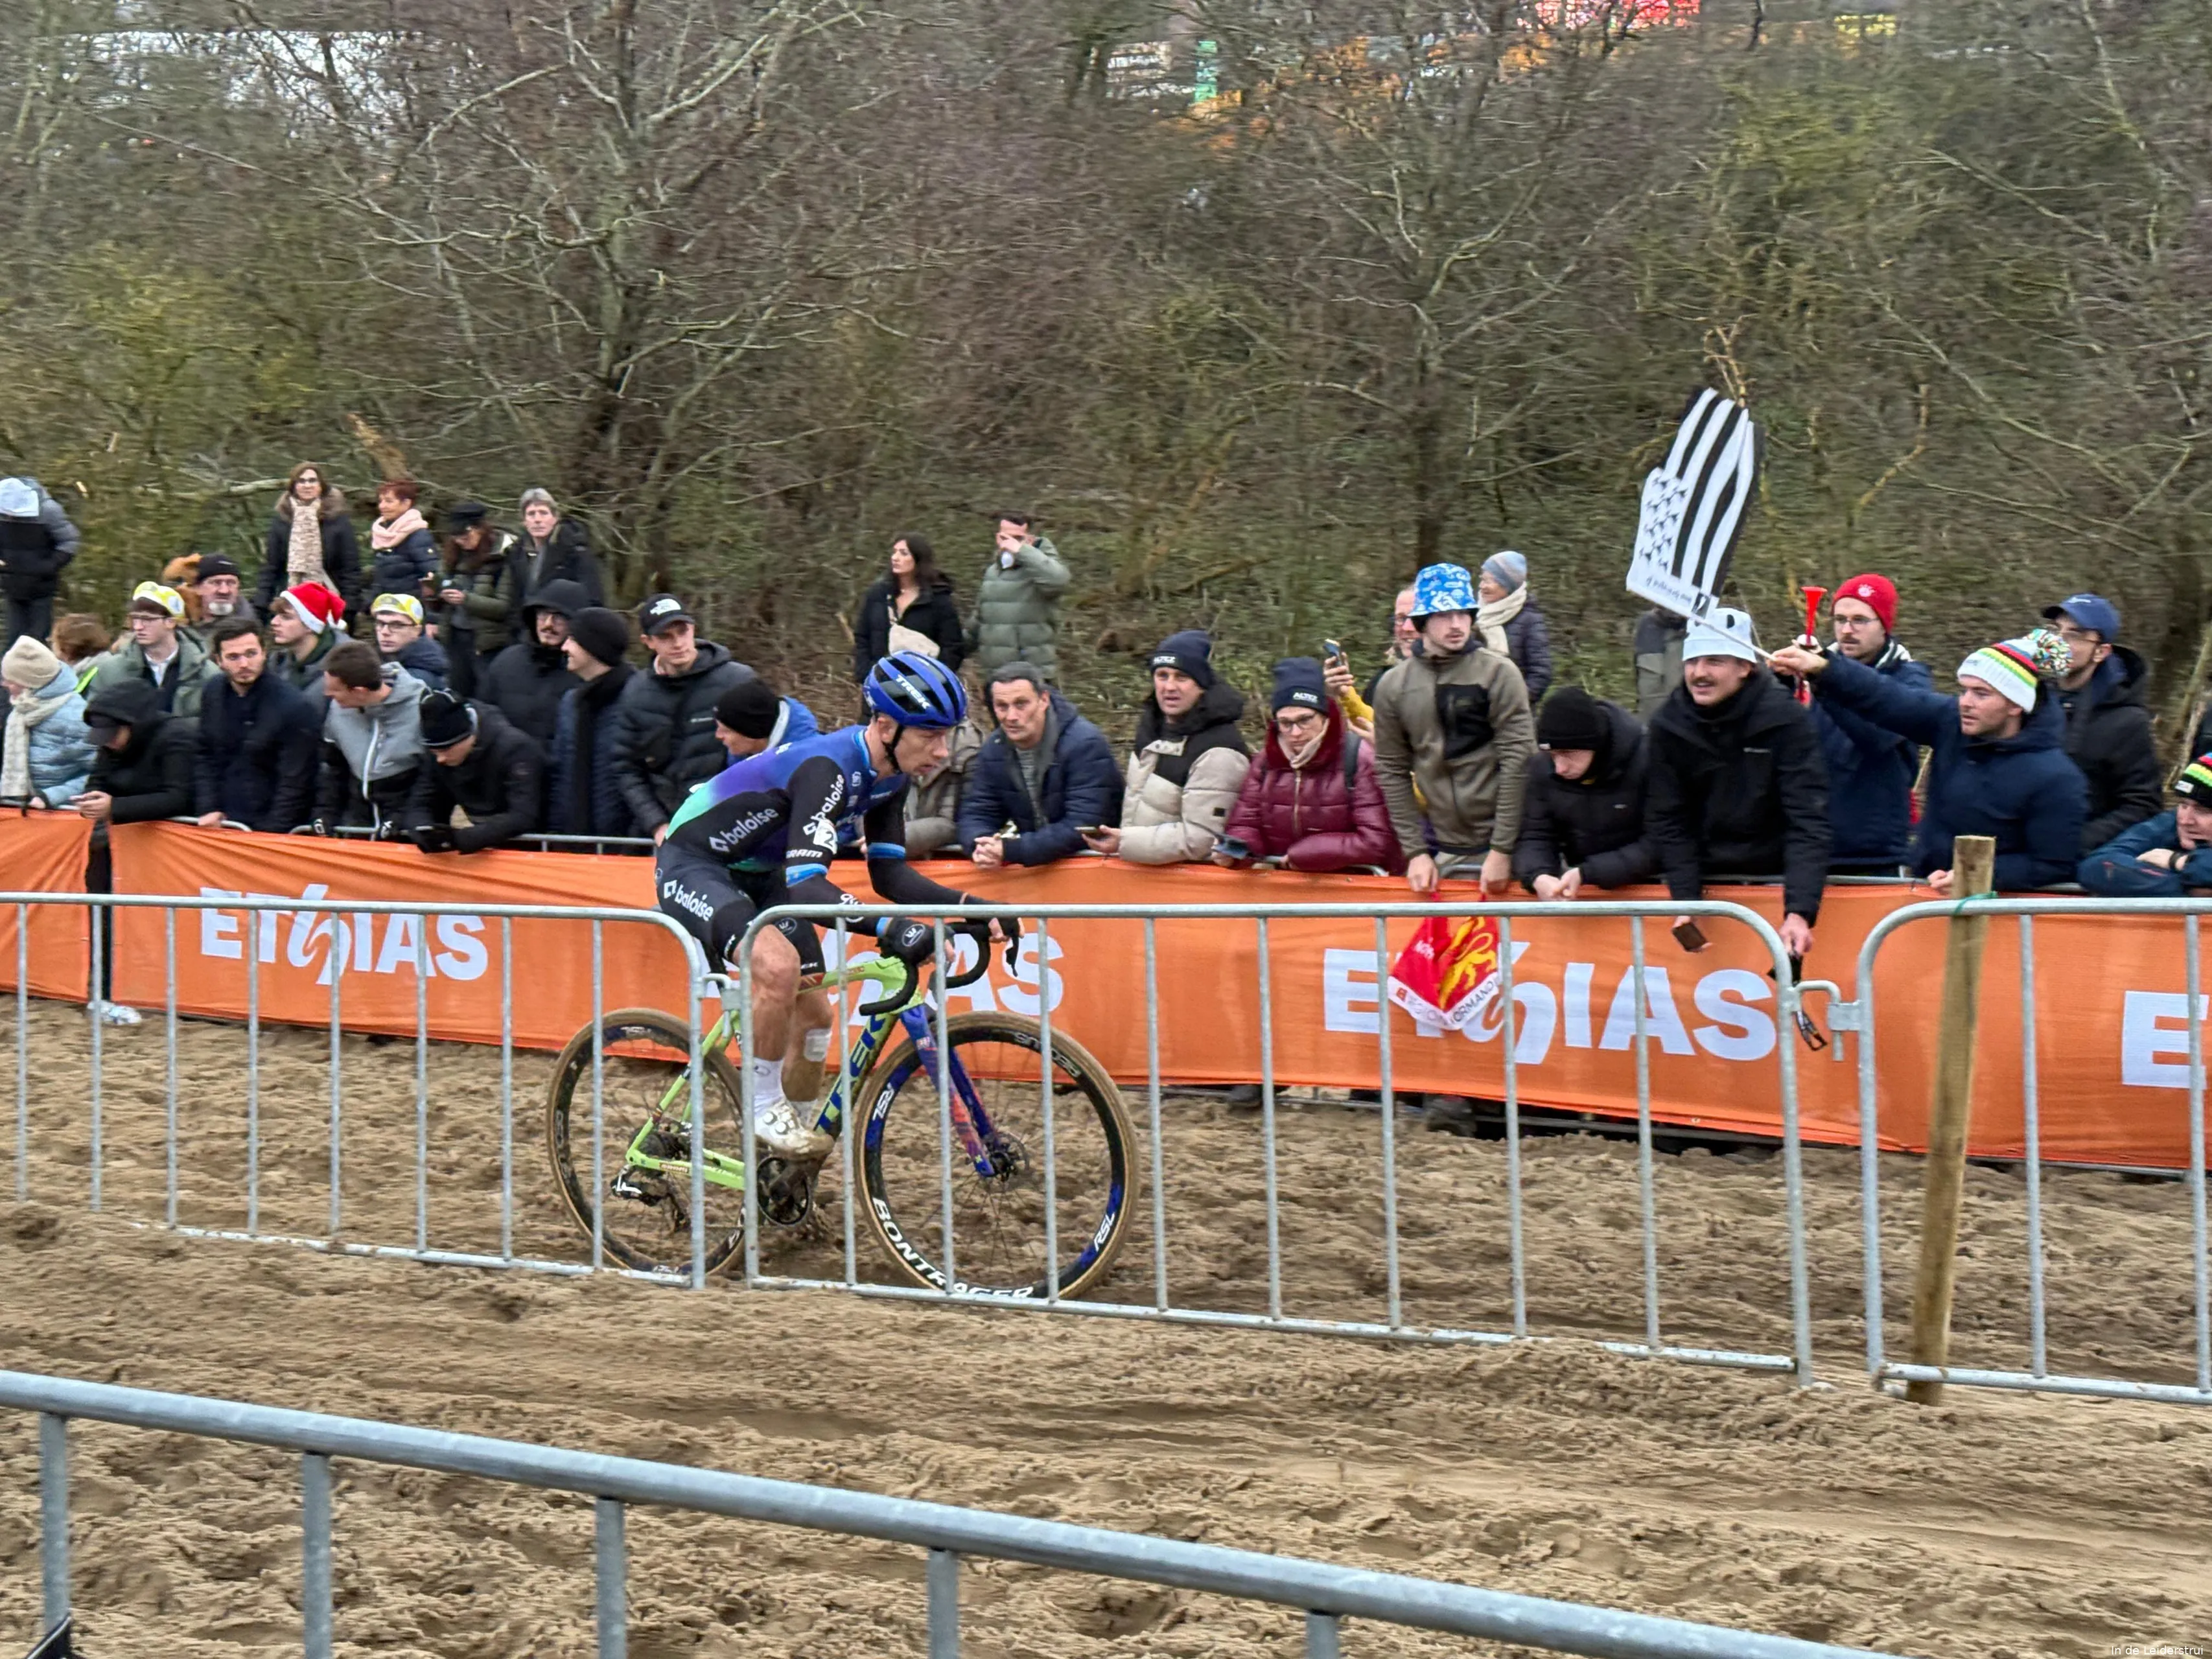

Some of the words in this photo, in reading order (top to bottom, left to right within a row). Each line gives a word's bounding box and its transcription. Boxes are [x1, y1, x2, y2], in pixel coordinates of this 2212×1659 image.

[896, 674, 931, 710] TREK
[721, 807, 779, 846] baloise
[674, 883, 715, 922] baloise
[1093, 1212, 1115, 1252] RSL
